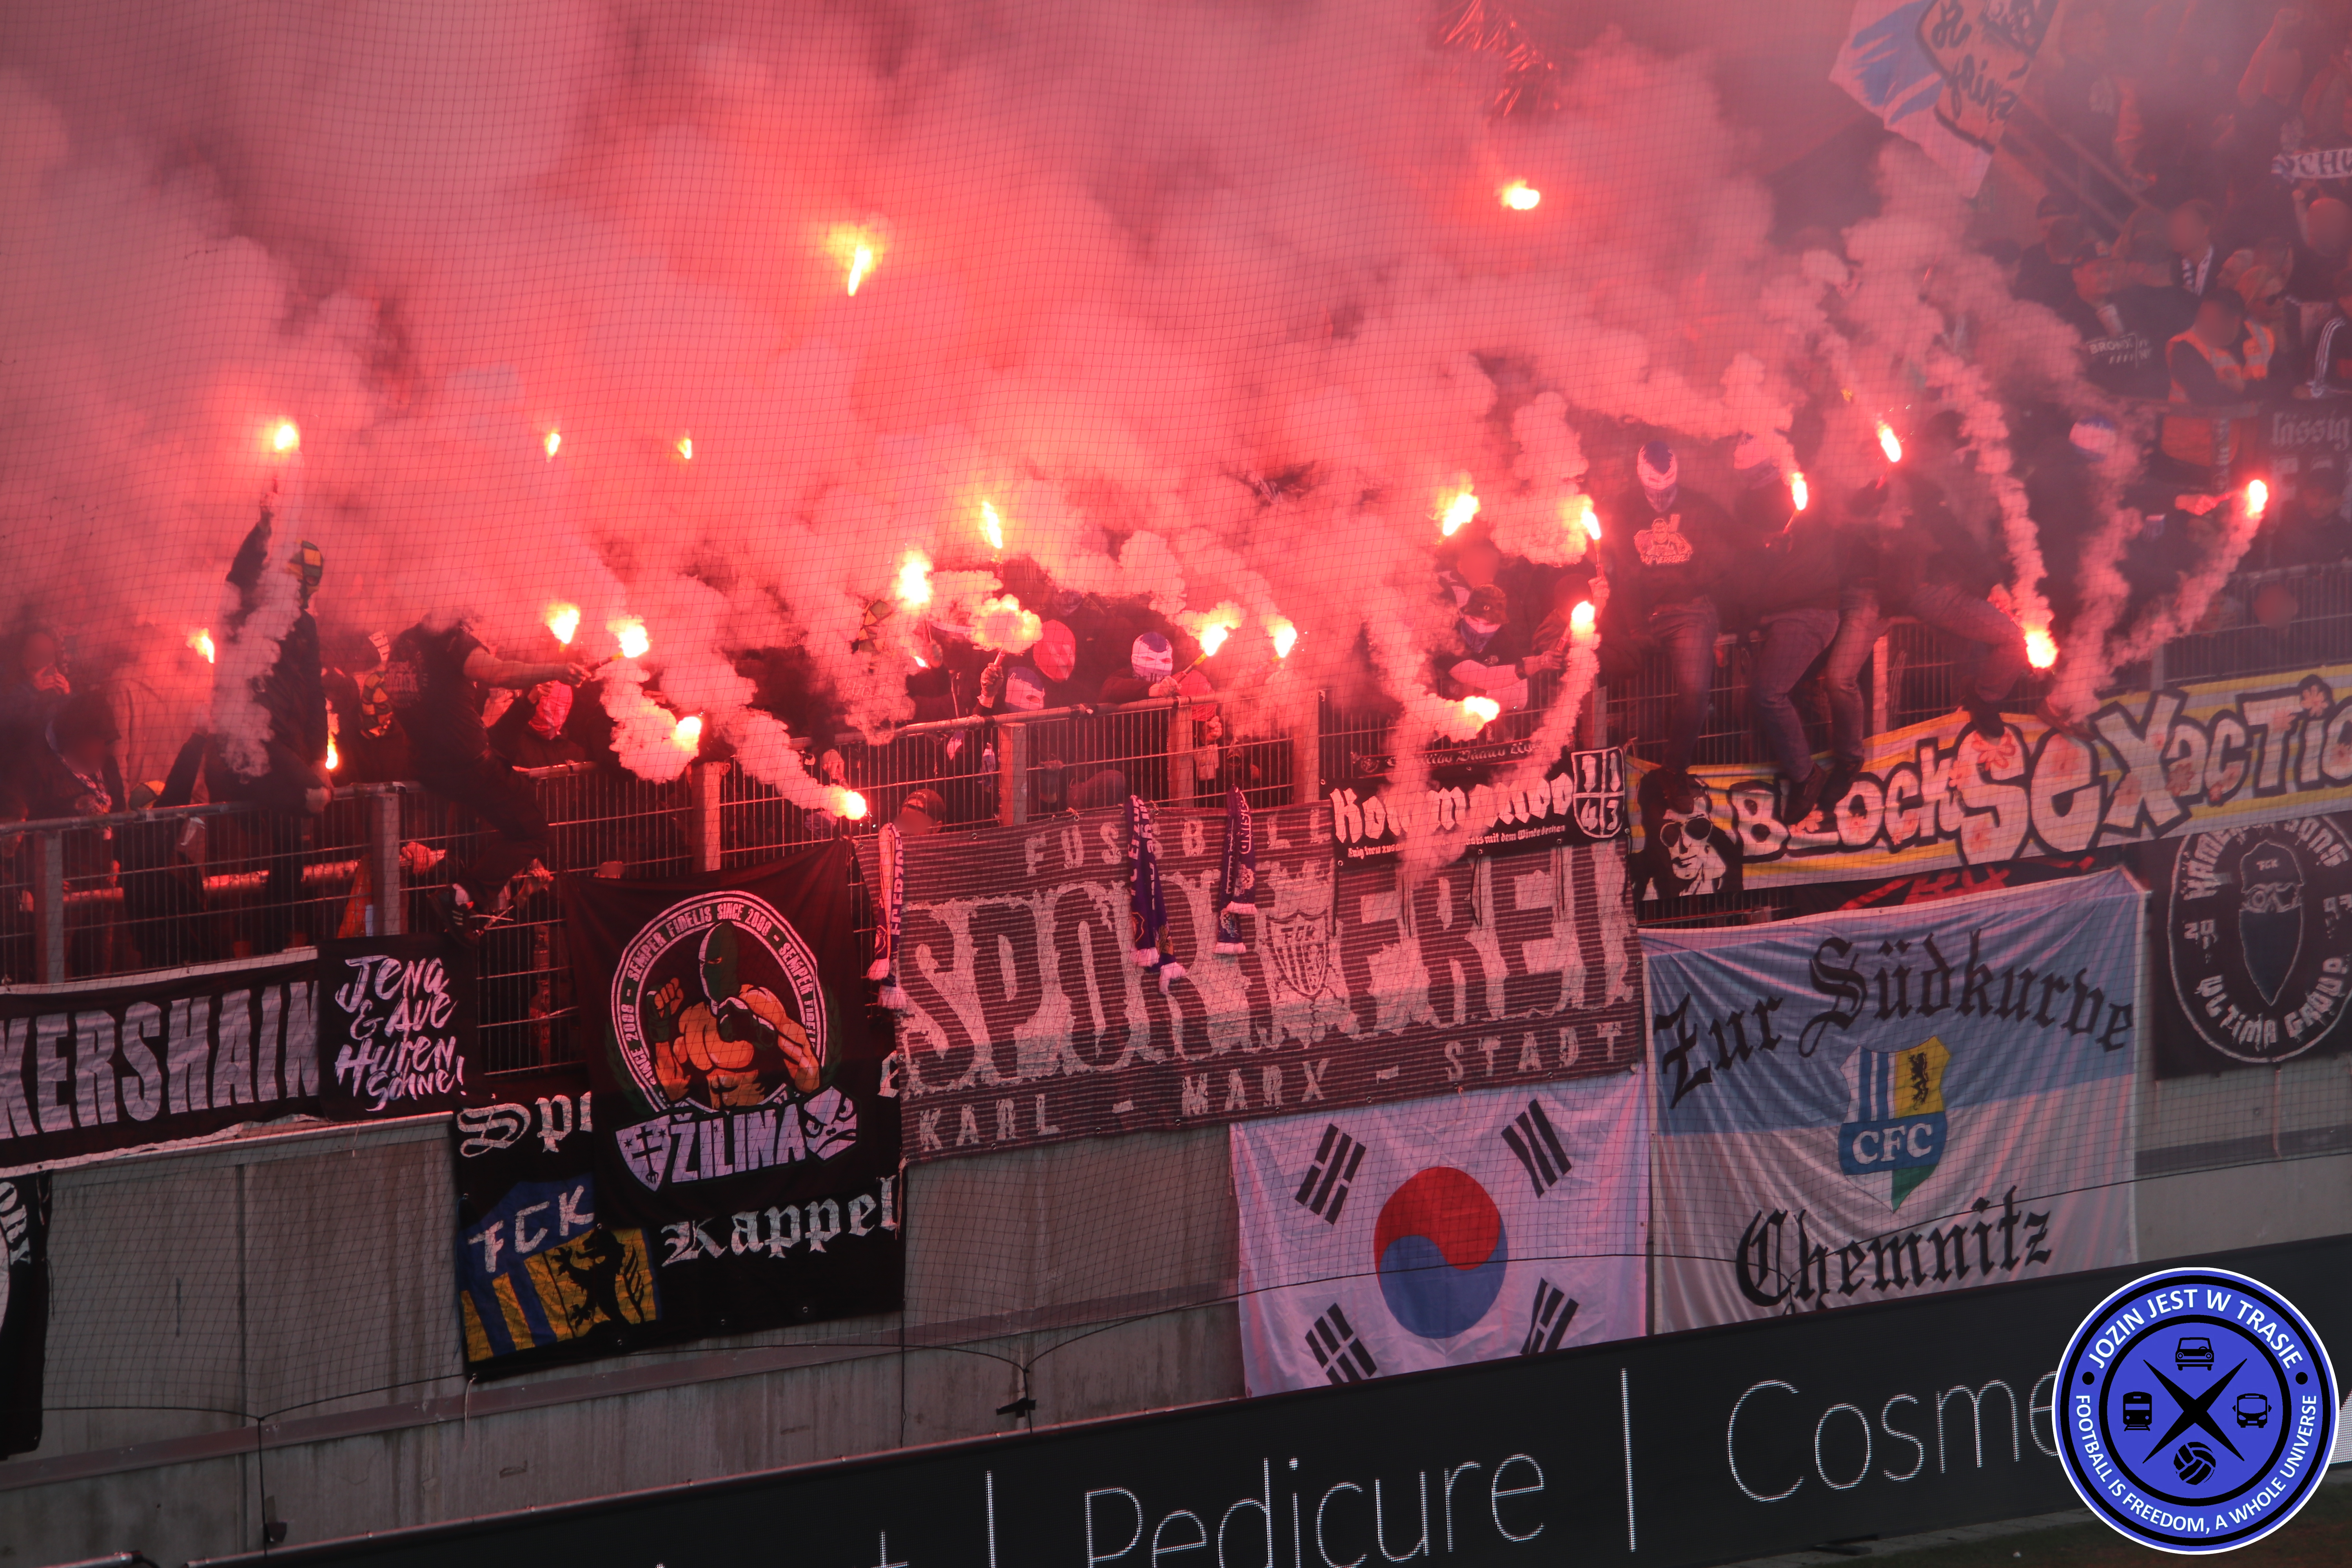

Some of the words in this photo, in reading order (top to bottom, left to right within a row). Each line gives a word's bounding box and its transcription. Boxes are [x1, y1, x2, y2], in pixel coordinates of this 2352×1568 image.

[665, 906, 713, 938] FIDELIS
[717, 902, 744, 921] SINCE
[745, 908, 772, 936] 2008
[627, 931, 667, 982] SEMPER
[778, 942, 813, 996] SEMPER
[350, 999, 384, 1040] &
[621, 1004, 639, 1042] 2008
[1653, 993, 1783, 1110] Zur
[1798, 928, 2134, 1058] Südkurve
[919, 1093, 1061, 1151] KARL
[1181, 1058, 1329, 1117] MARX
[1444, 1021, 1622, 1082] STADT
[670, 1103, 806, 1183] ŽILINA
[1852, 1123, 1933, 1165] CFC
[468, 1185, 595, 1273] FCK
[661, 1175, 898, 1267] Kappel
[1735, 1185, 2053, 1312] Chemnitz
[1085, 1452, 1544, 1568] Pedicure
